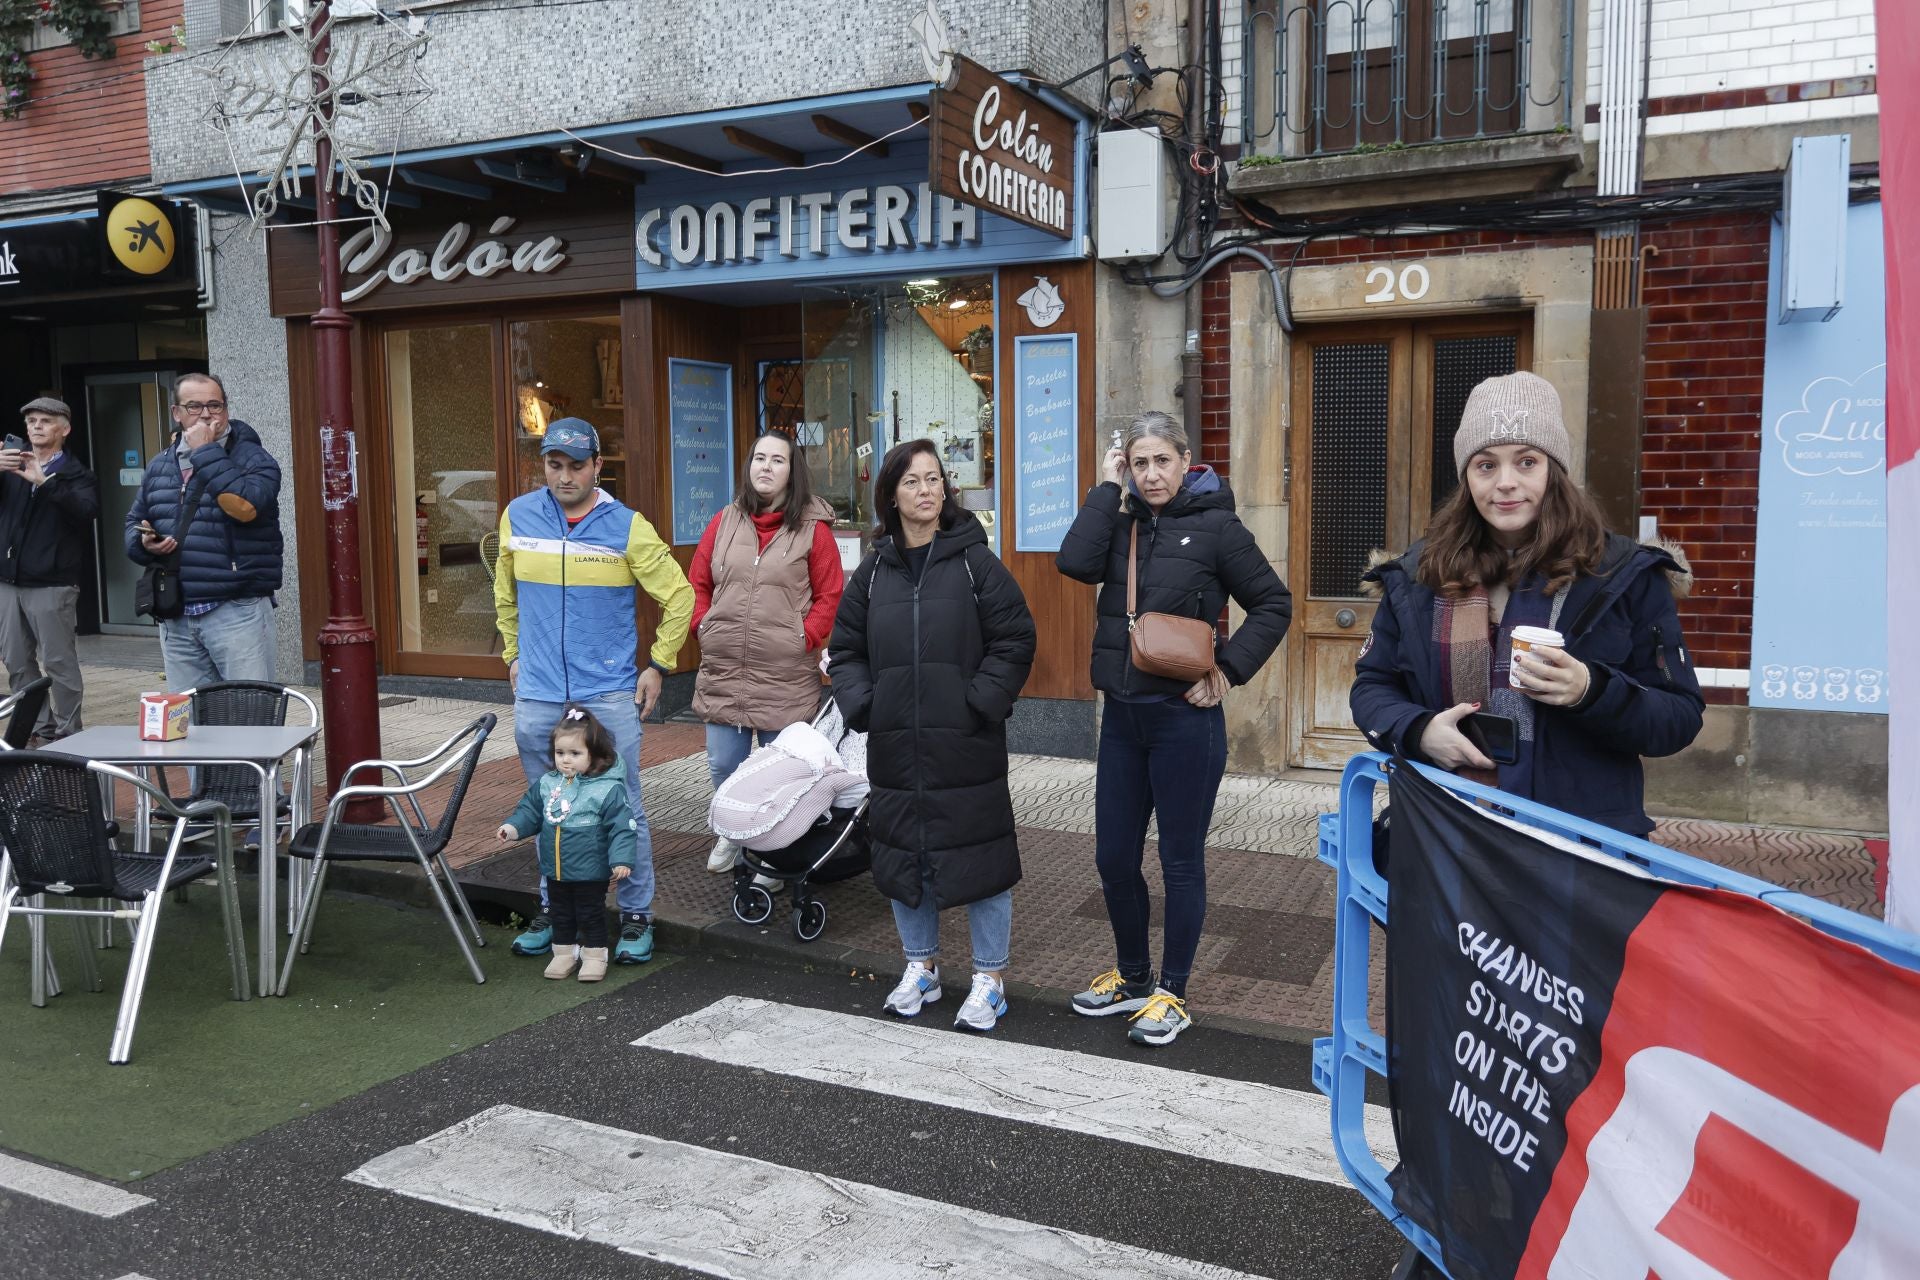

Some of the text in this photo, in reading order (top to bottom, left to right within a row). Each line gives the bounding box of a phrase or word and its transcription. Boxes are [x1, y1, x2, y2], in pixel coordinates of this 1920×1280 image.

[973, 85, 1053, 174] Colón
[959, 150, 1065, 231] CONFITERIA
[1365, 264, 1430, 304] 20
[1027, 368, 1067, 388] Pasteles
[1026, 398, 1072, 417] Bombones
[1491, 409, 1529, 440] M
[1795, 398, 1886, 441] Luc
[1028, 427, 1068, 444] Helados
[1022, 452, 1073, 474] Mermelada
[1795, 451, 1822, 460] MODA
[1031, 474, 1066, 488] caseras
[1059, 498, 1071, 509] de
[1458, 921, 1585, 1025] CHANGES
[1466, 980, 1576, 1074] STARTS
[1455, 1030, 1551, 1124] ON THE
[1449, 1080, 1540, 1172] INSIDE
